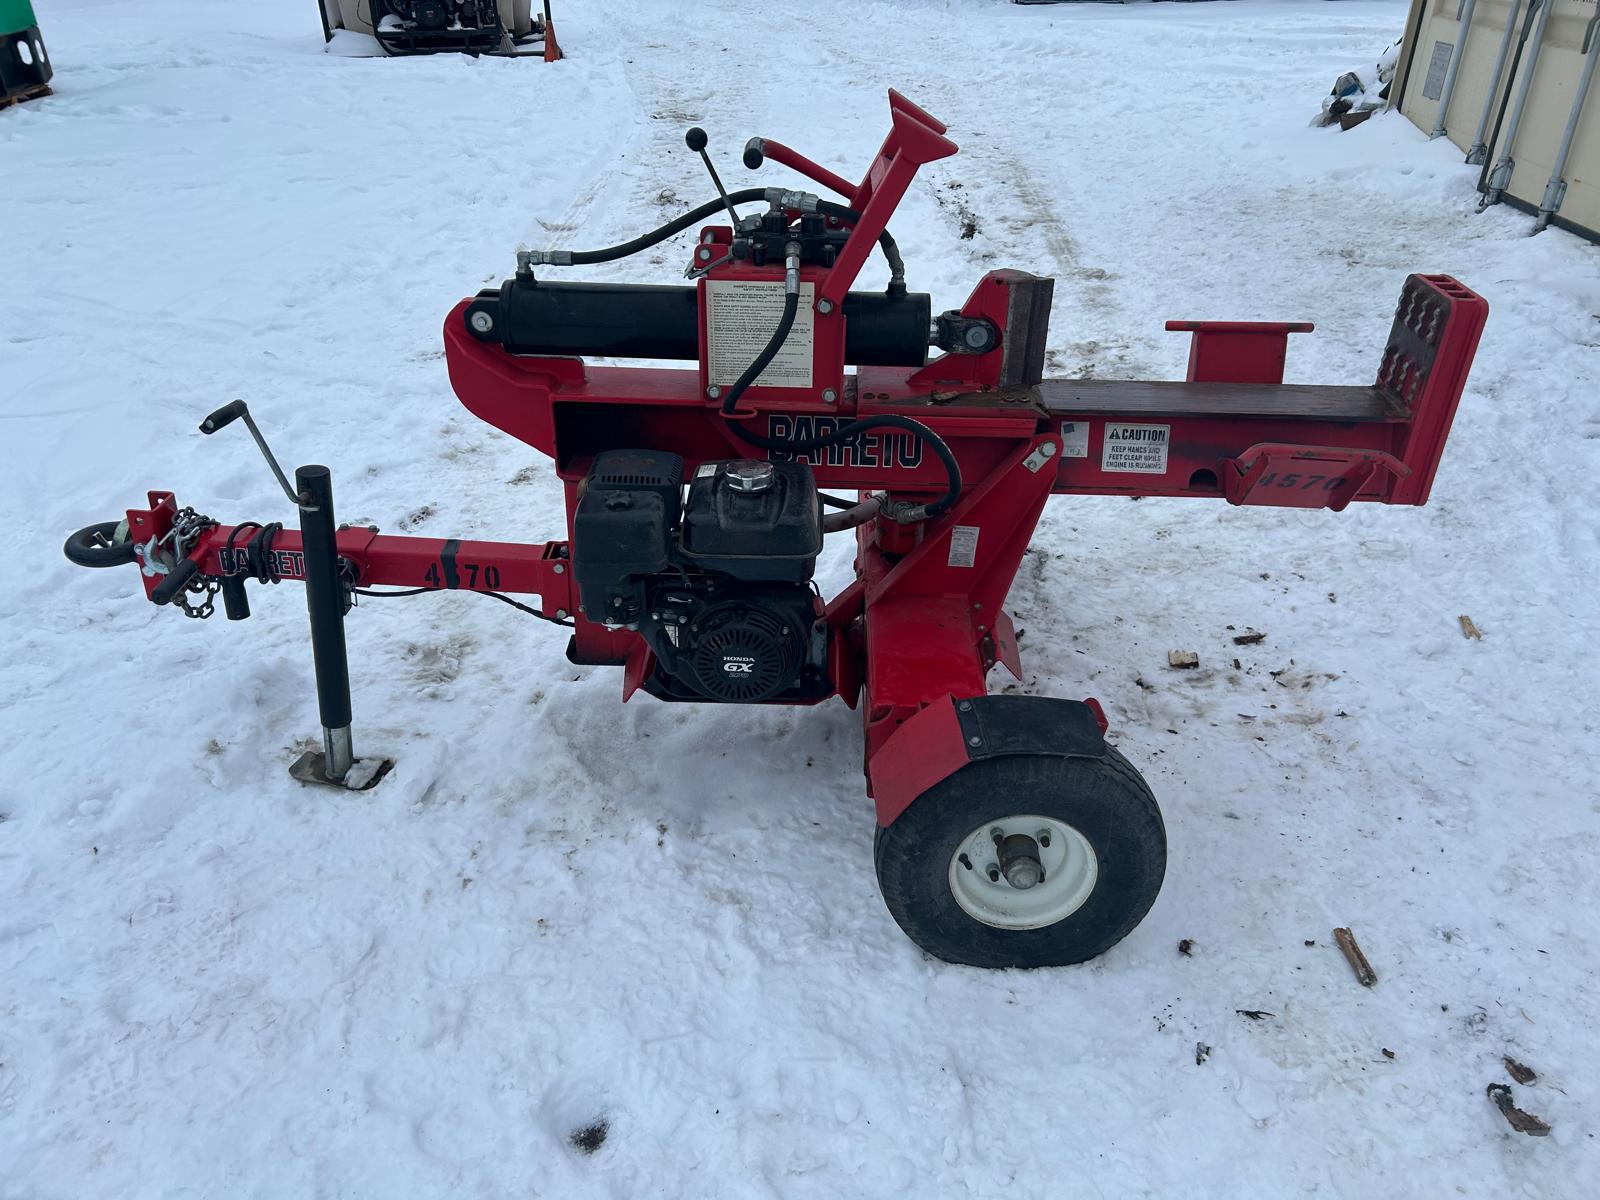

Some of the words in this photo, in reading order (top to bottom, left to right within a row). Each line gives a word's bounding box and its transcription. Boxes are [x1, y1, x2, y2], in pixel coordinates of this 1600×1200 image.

[1121, 428, 1165, 441] CAUTION
[1111, 445, 1126, 453] KEEP
[1127, 446, 1147, 454] HANDS
[1108, 453, 1123, 461] FEET
[1124, 454, 1143, 462] CLEAR
[1259, 473, 1345, 490] 4570
[724, 662, 754, 672] GX
